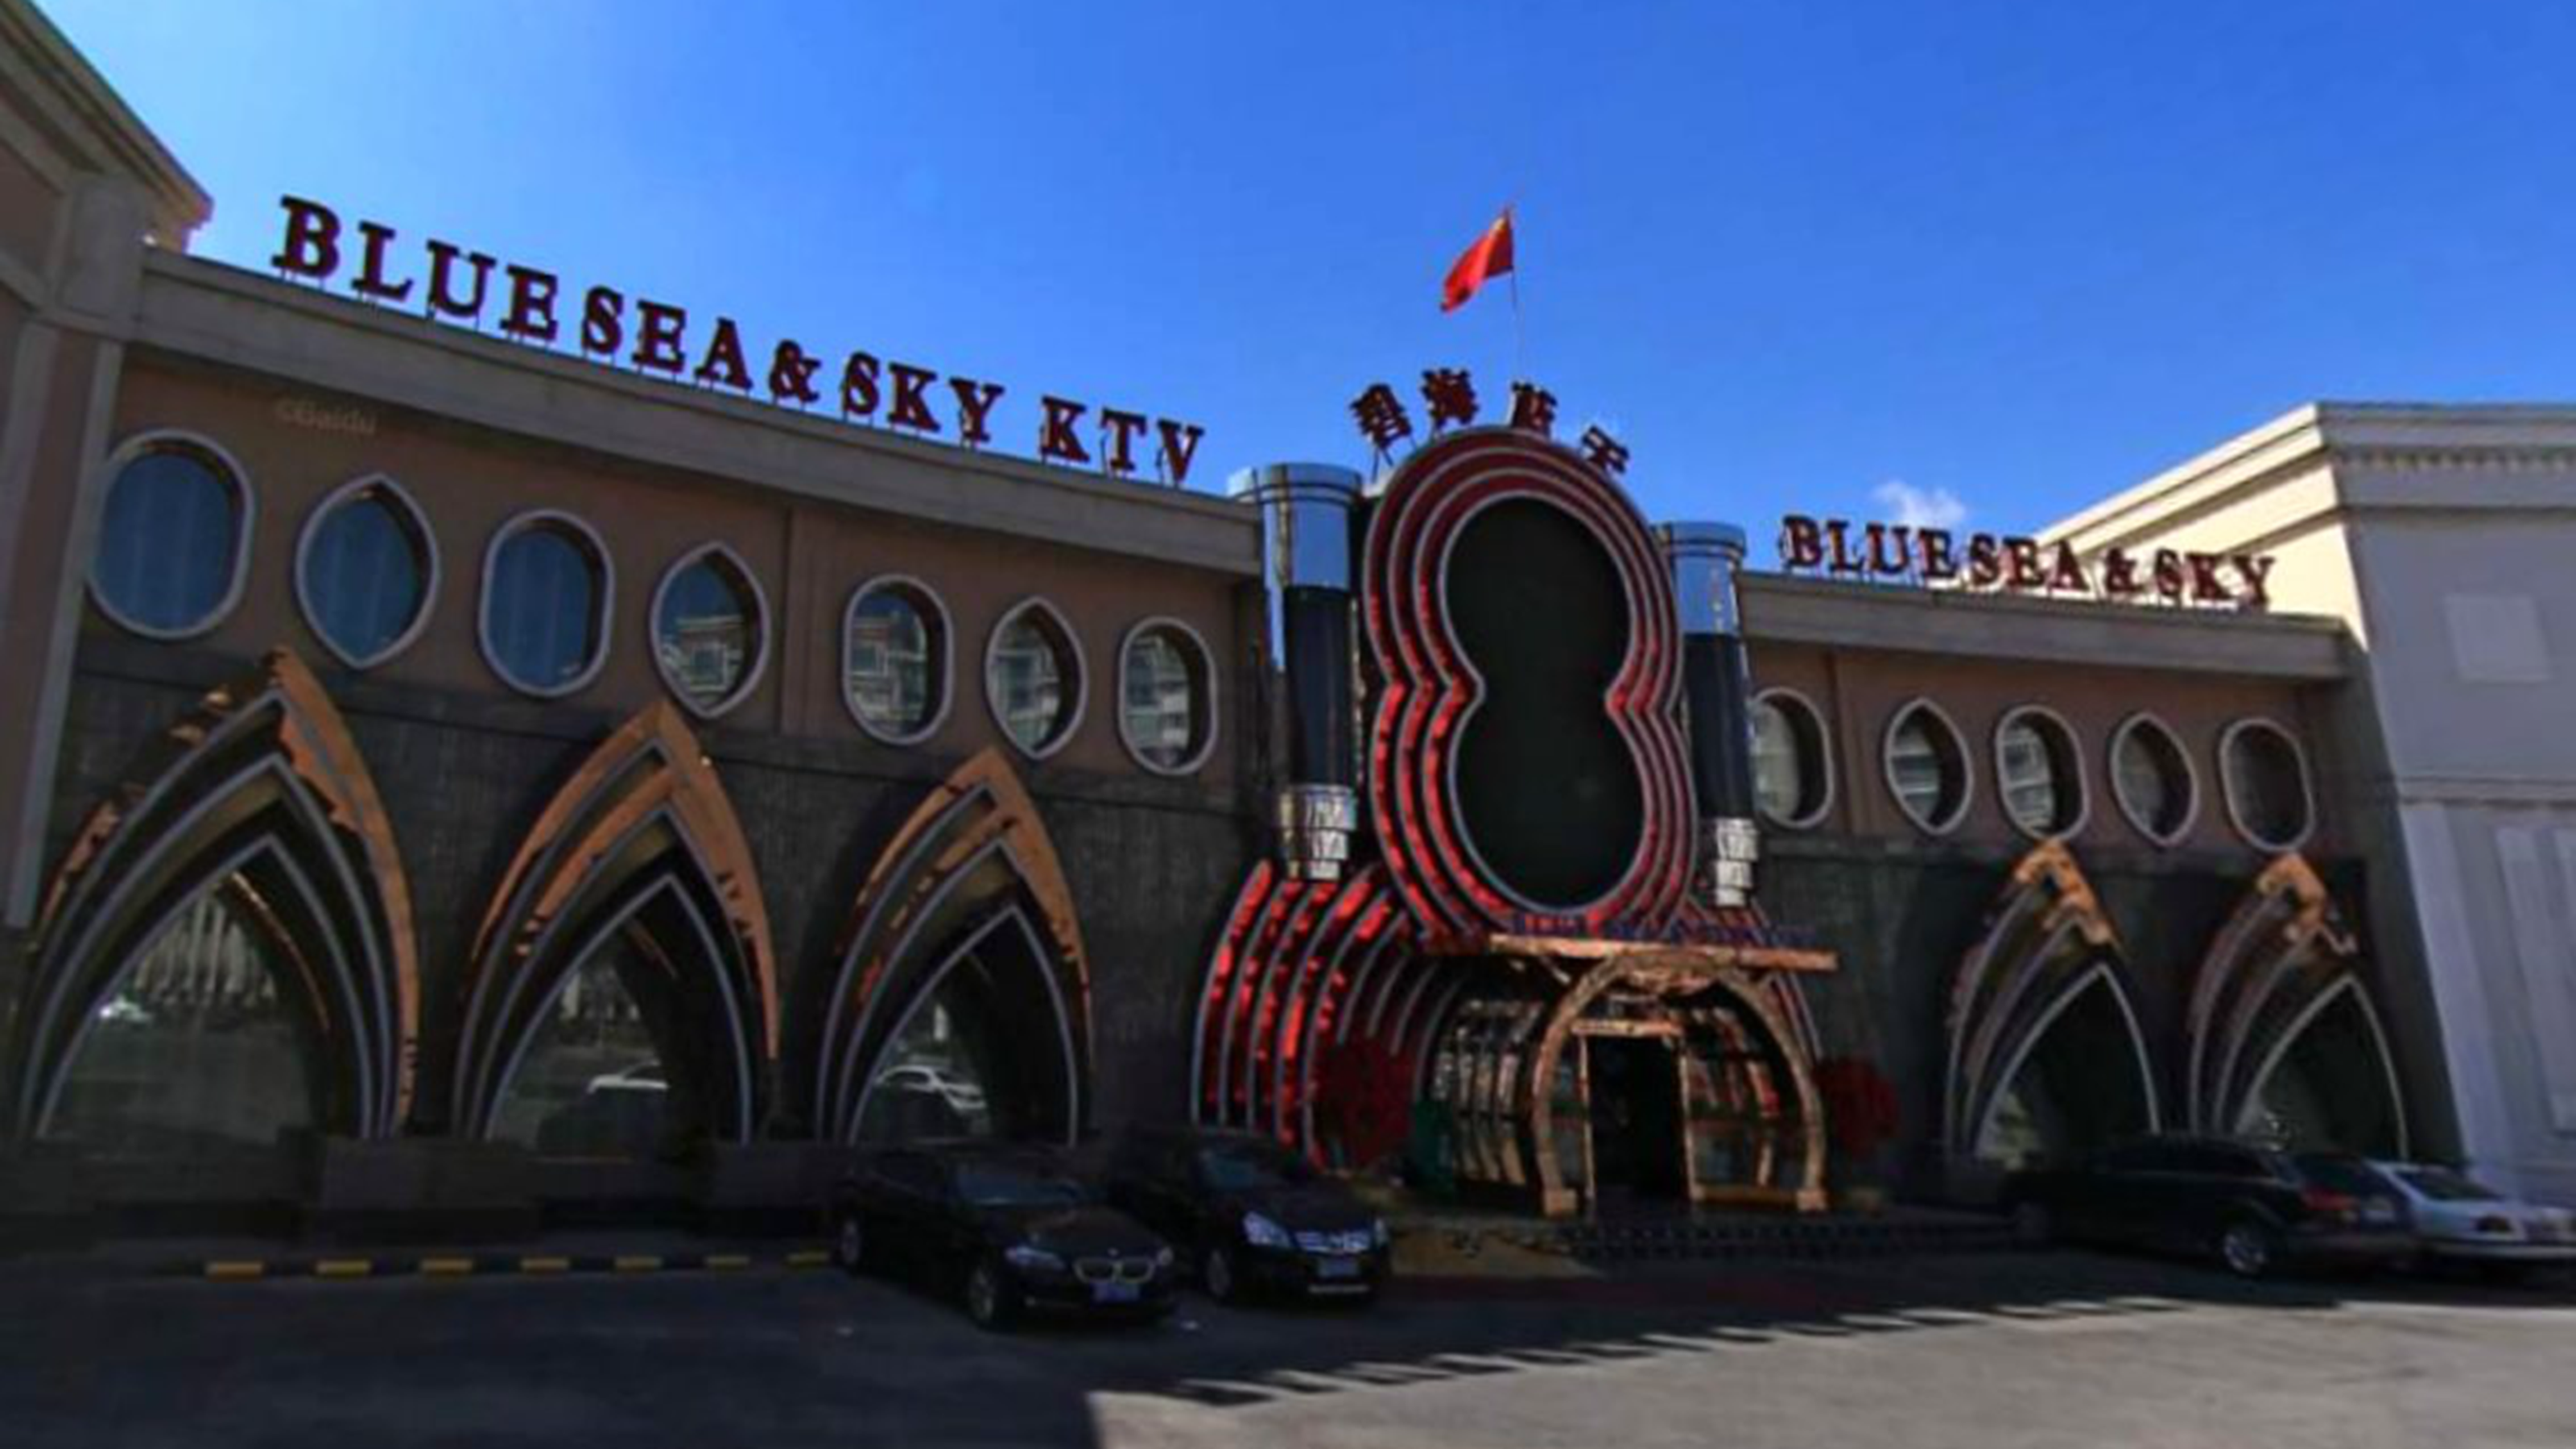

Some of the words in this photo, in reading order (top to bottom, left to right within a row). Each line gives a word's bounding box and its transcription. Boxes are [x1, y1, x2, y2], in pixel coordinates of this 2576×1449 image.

[840, 351, 1005, 443] SKY
[1039, 394, 1205, 483] KTV
[2152, 547, 2277, 609] SKY
